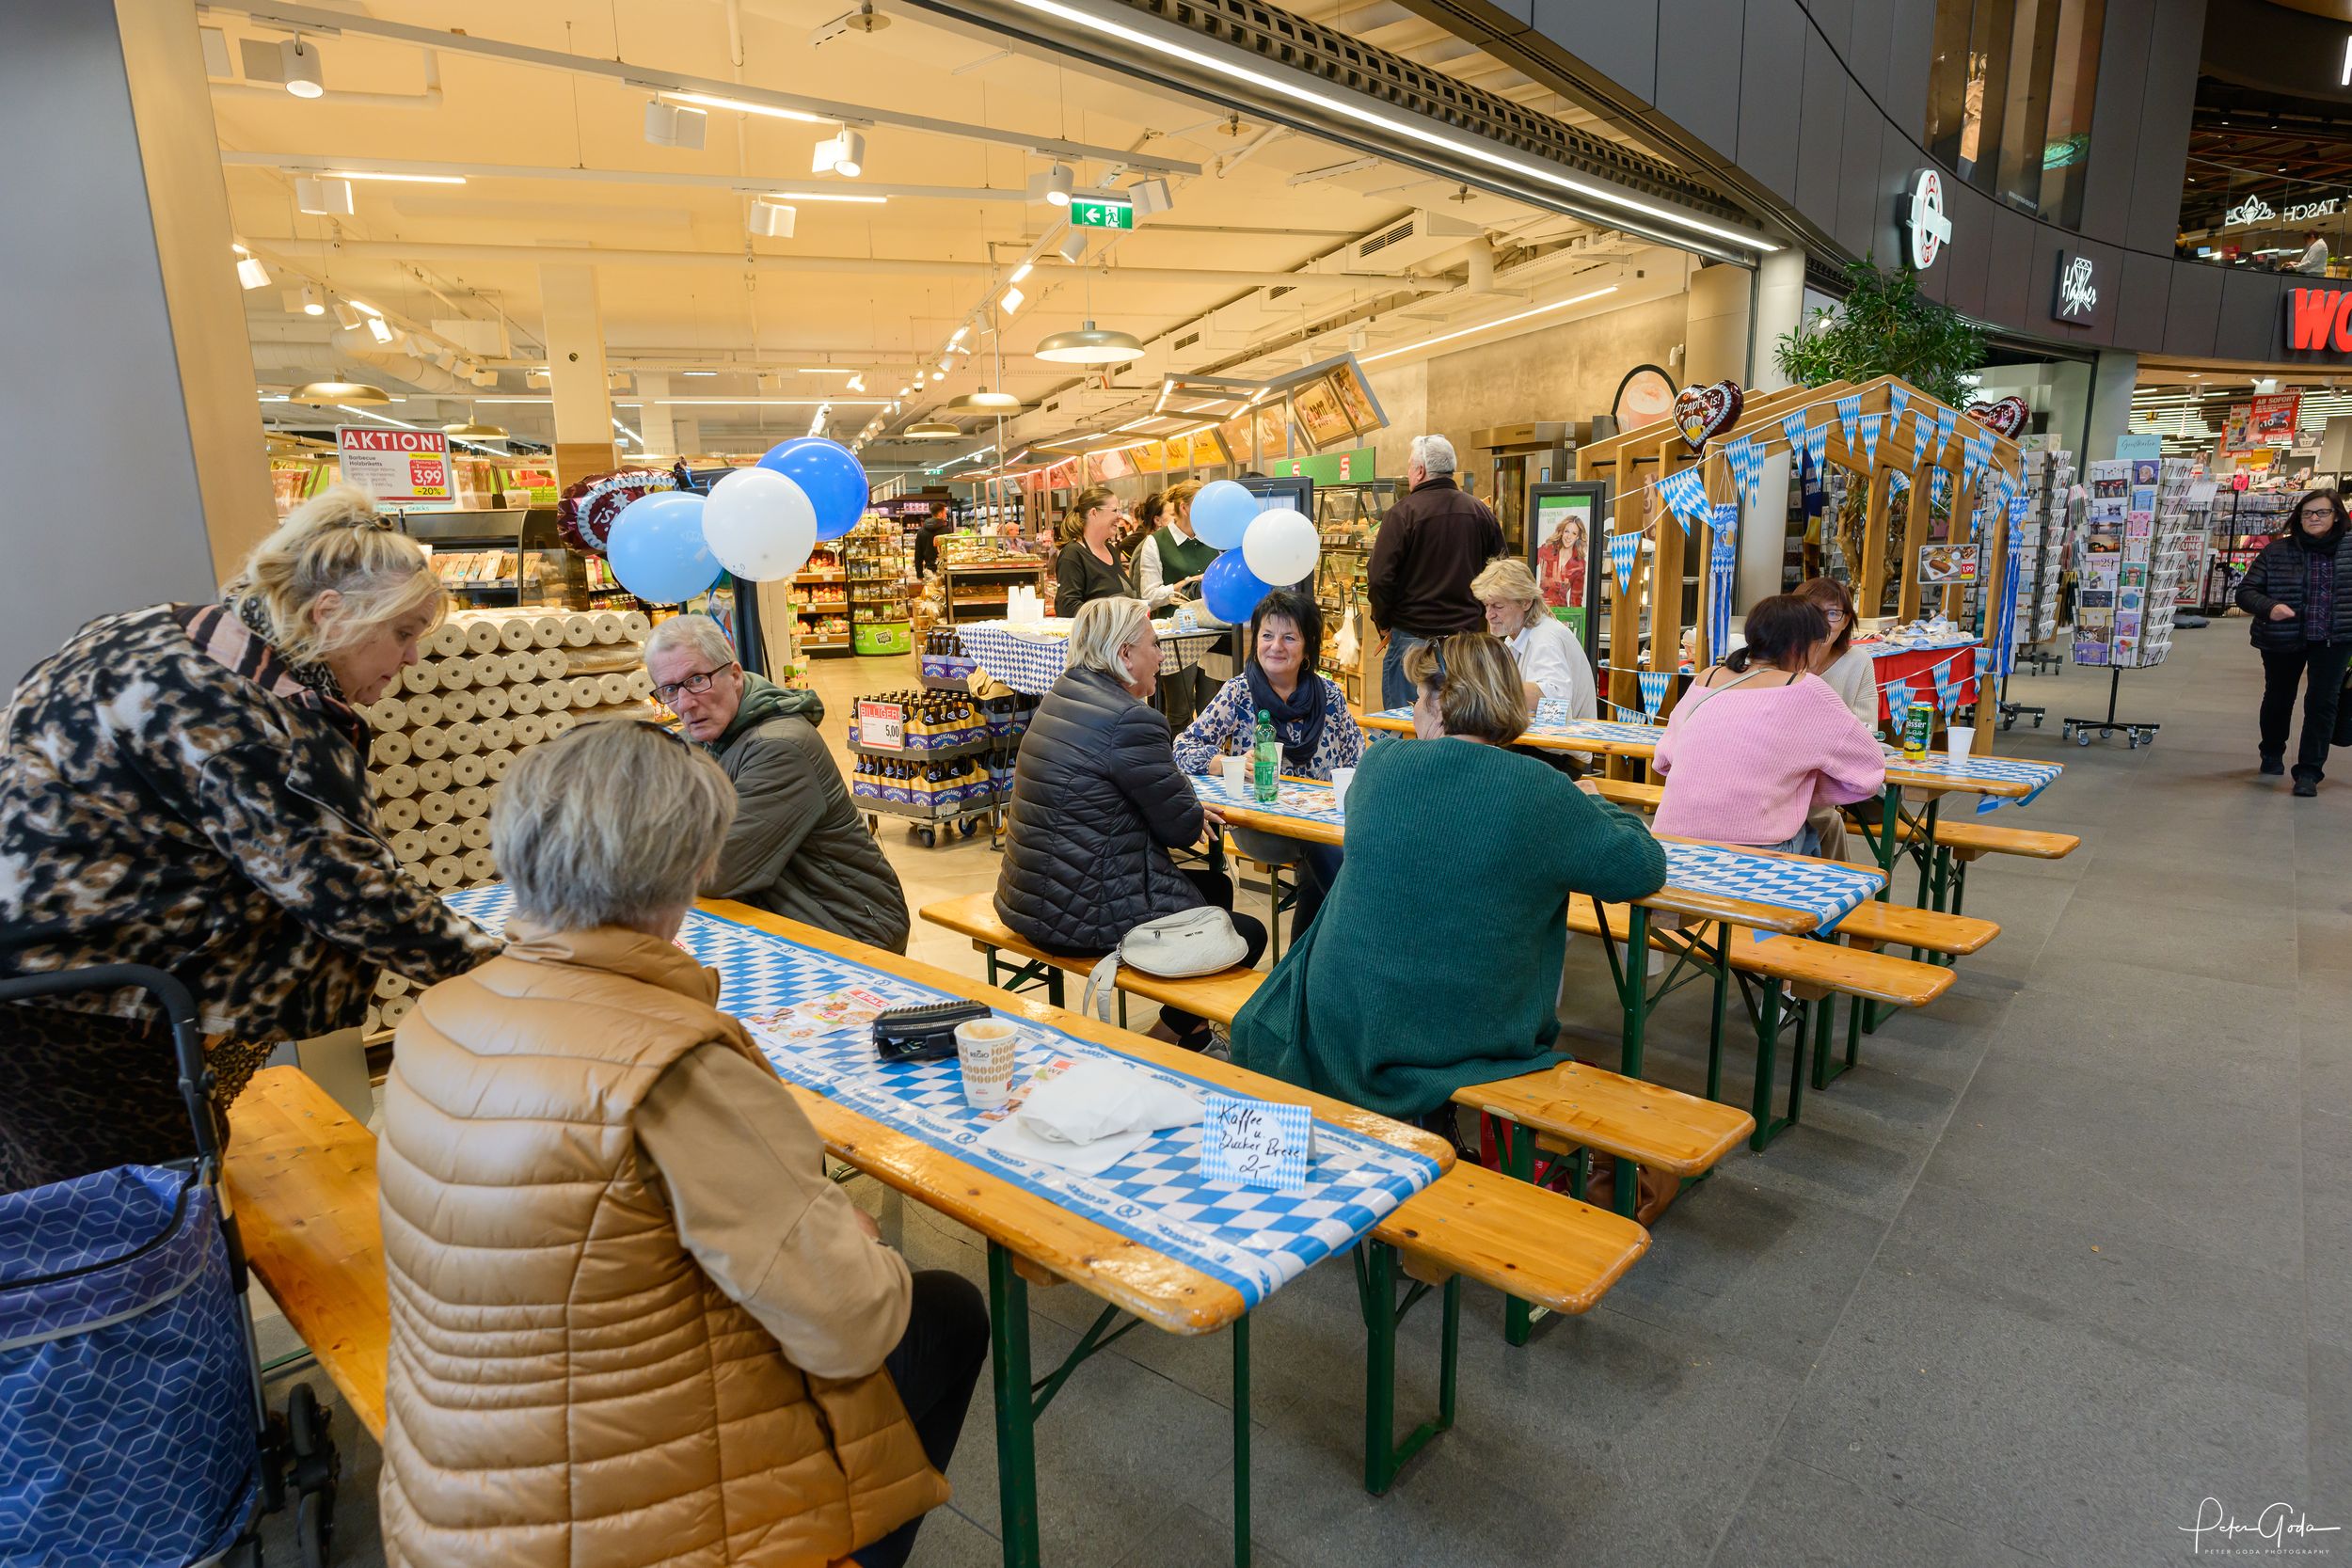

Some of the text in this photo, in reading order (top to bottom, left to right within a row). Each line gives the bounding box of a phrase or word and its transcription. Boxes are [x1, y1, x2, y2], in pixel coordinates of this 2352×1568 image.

[1675, 393, 1722, 417] O'zapft is!
[2268, 395, 2296, 404] SOFORT
[343, 431, 443, 451] AKTION!
[414, 469, 442, 486] 3,99
[1962, 565, 1975, 574] 1,99
[860, 706, 900, 721] BILLIGER!
[885, 724, 899, 740] 5,00
[930, 733, 960, 746] PUNTIGAMER
[934, 789, 962, 802] PUNTIGAMER
[1216, 1103, 1263, 1135] Kaffee
[1218, 1130, 1262, 1150] Zucker
